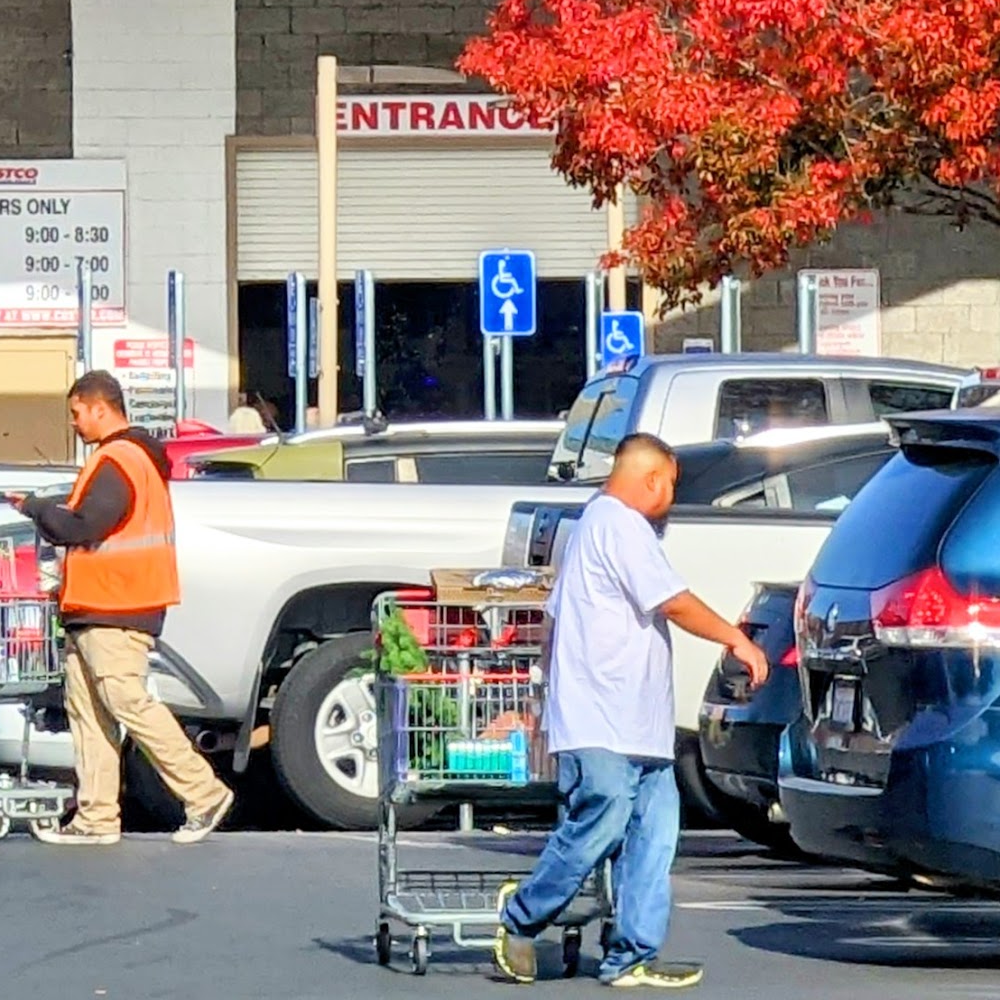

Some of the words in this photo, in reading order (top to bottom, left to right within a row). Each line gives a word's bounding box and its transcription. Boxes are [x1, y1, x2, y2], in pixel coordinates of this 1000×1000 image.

[27, 198, 71, 215] ONLY
[25, 226, 60, 243] 9:00
[75, 226, 109, 243] 8:30
[25, 255, 60, 273] 9:00
[74, 256, 109, 272] 7:00
[26, 285, 60, 300] 9:00
